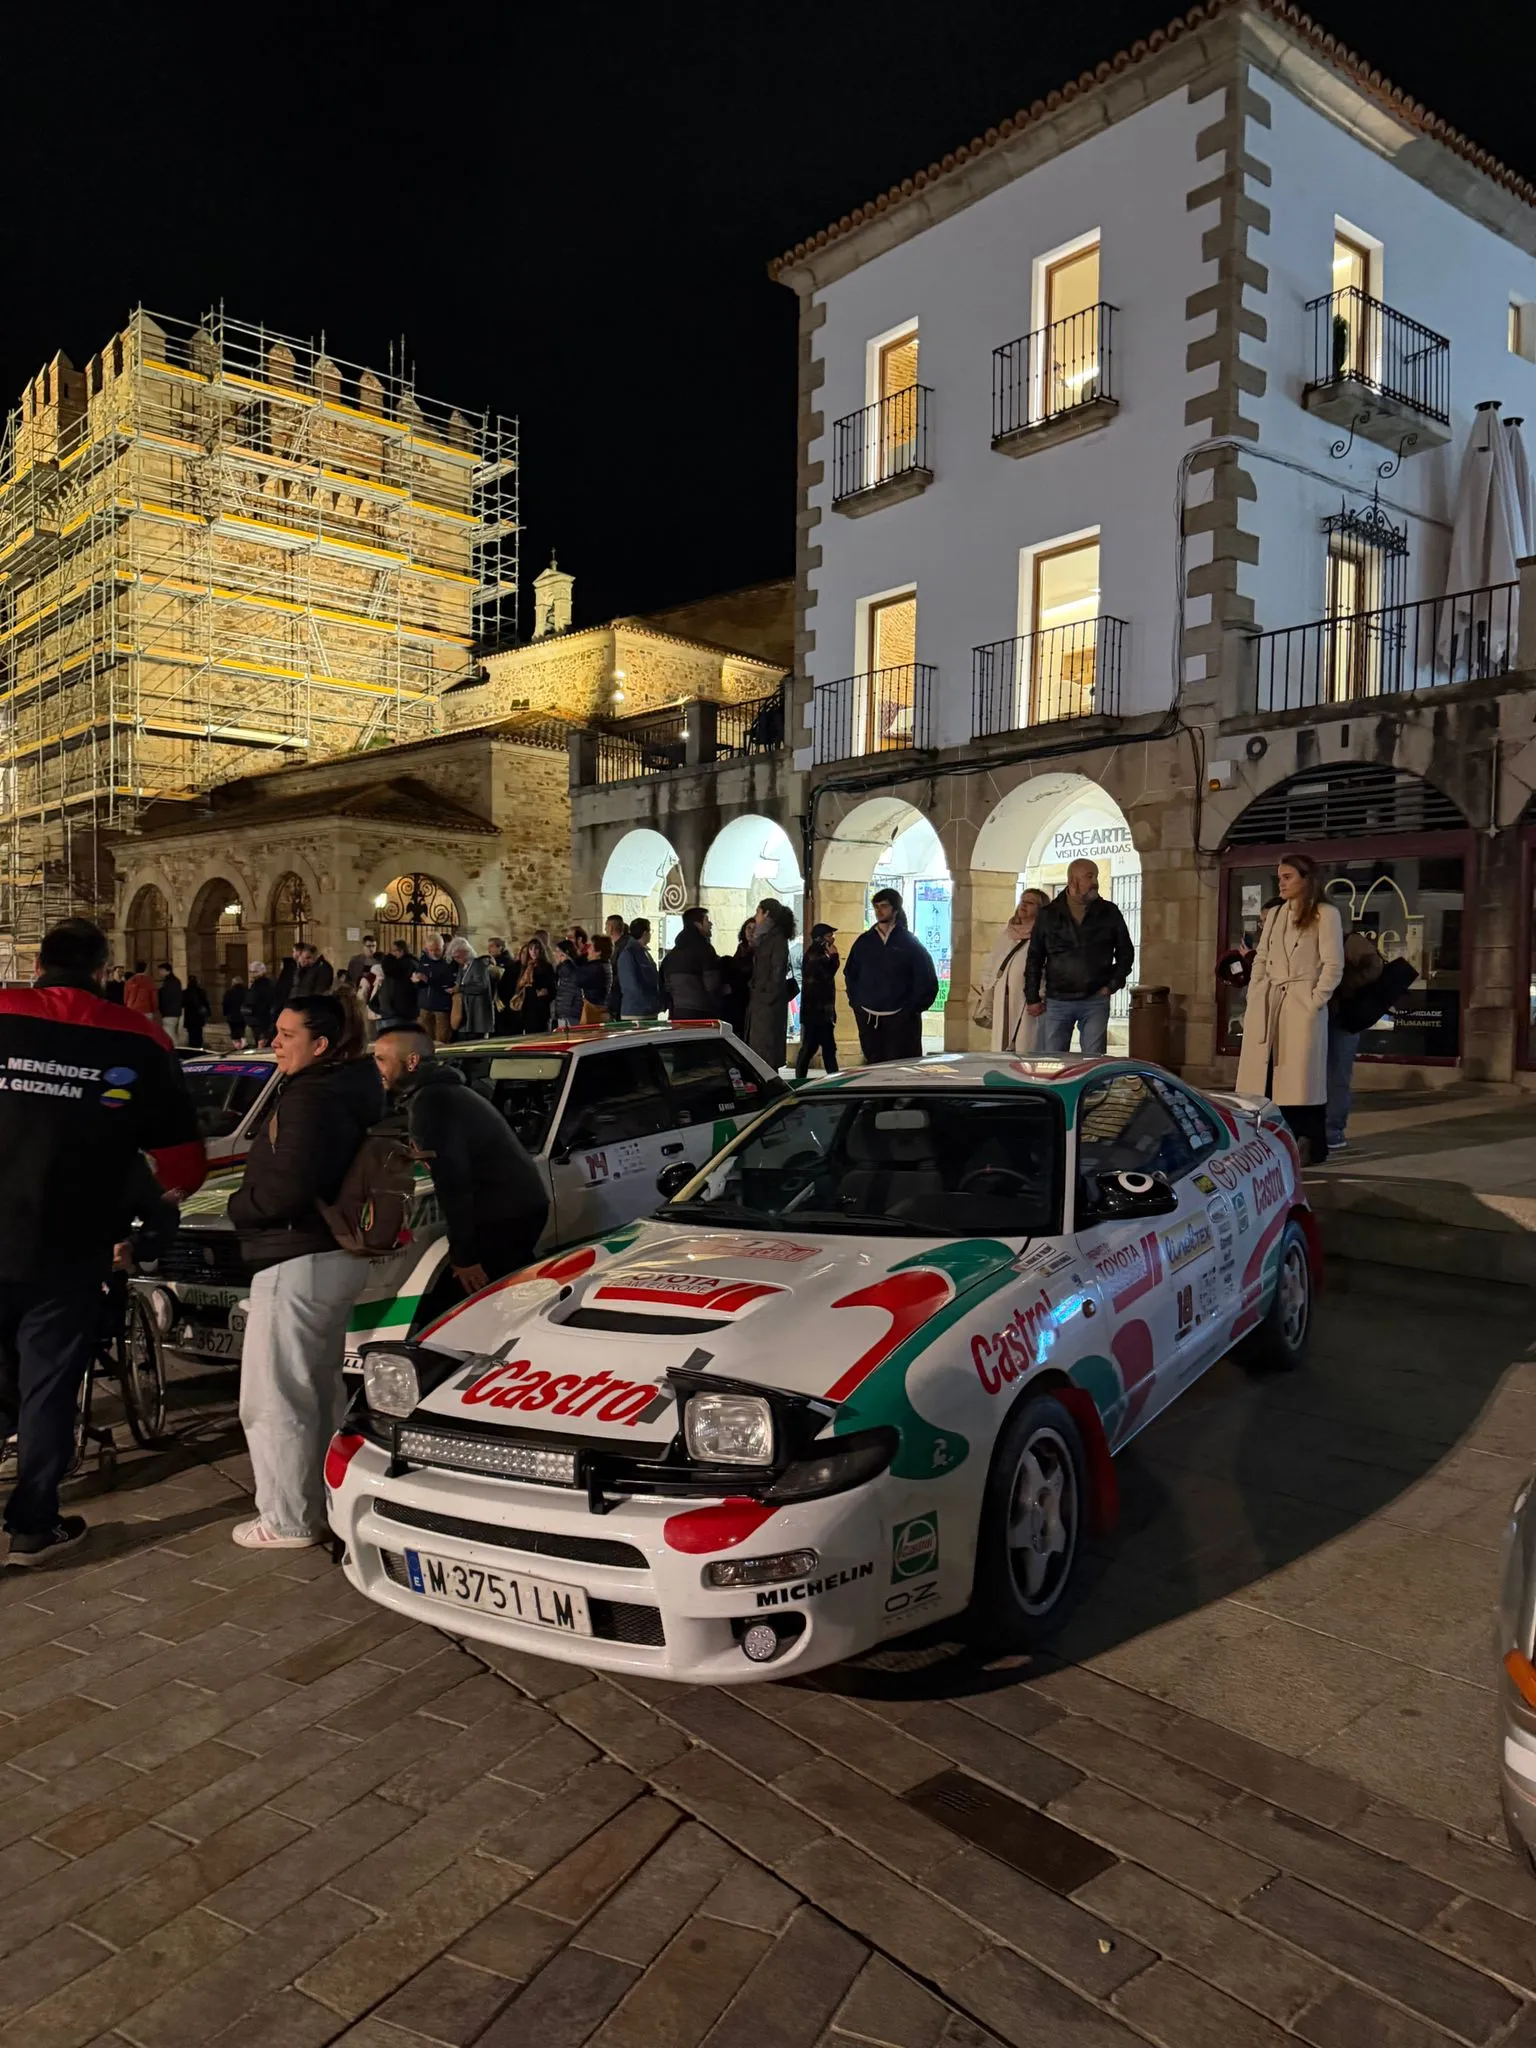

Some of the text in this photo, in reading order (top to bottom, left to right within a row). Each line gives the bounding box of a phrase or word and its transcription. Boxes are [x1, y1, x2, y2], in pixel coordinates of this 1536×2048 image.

[1055, 827, 1132, 848] PASEARTE
[1056, 844, 1132, 859] VISITAS GUIADAS
[7, 1057, 102, 1081] MENÉNDEZ
[10, 1078, 84, 1099] GUZMÁN
[1223, 1139, 1275, 1177] TOYOTA
[1252, 1160, 1286, 1216] Castrol
[1096, 1244, 1141, 1279] TOYOTA
[183, 1287, 239, 1308] Alitalia
[646, 1281, 712, 1294] EUROPE
[461, 1360, 659, 1426] Castro
[413, 1576, 421, 1587] E
[756, 1562, 874, 1607] MICHELIN
[427, 1559, 576, 1630] M 3751 LM
